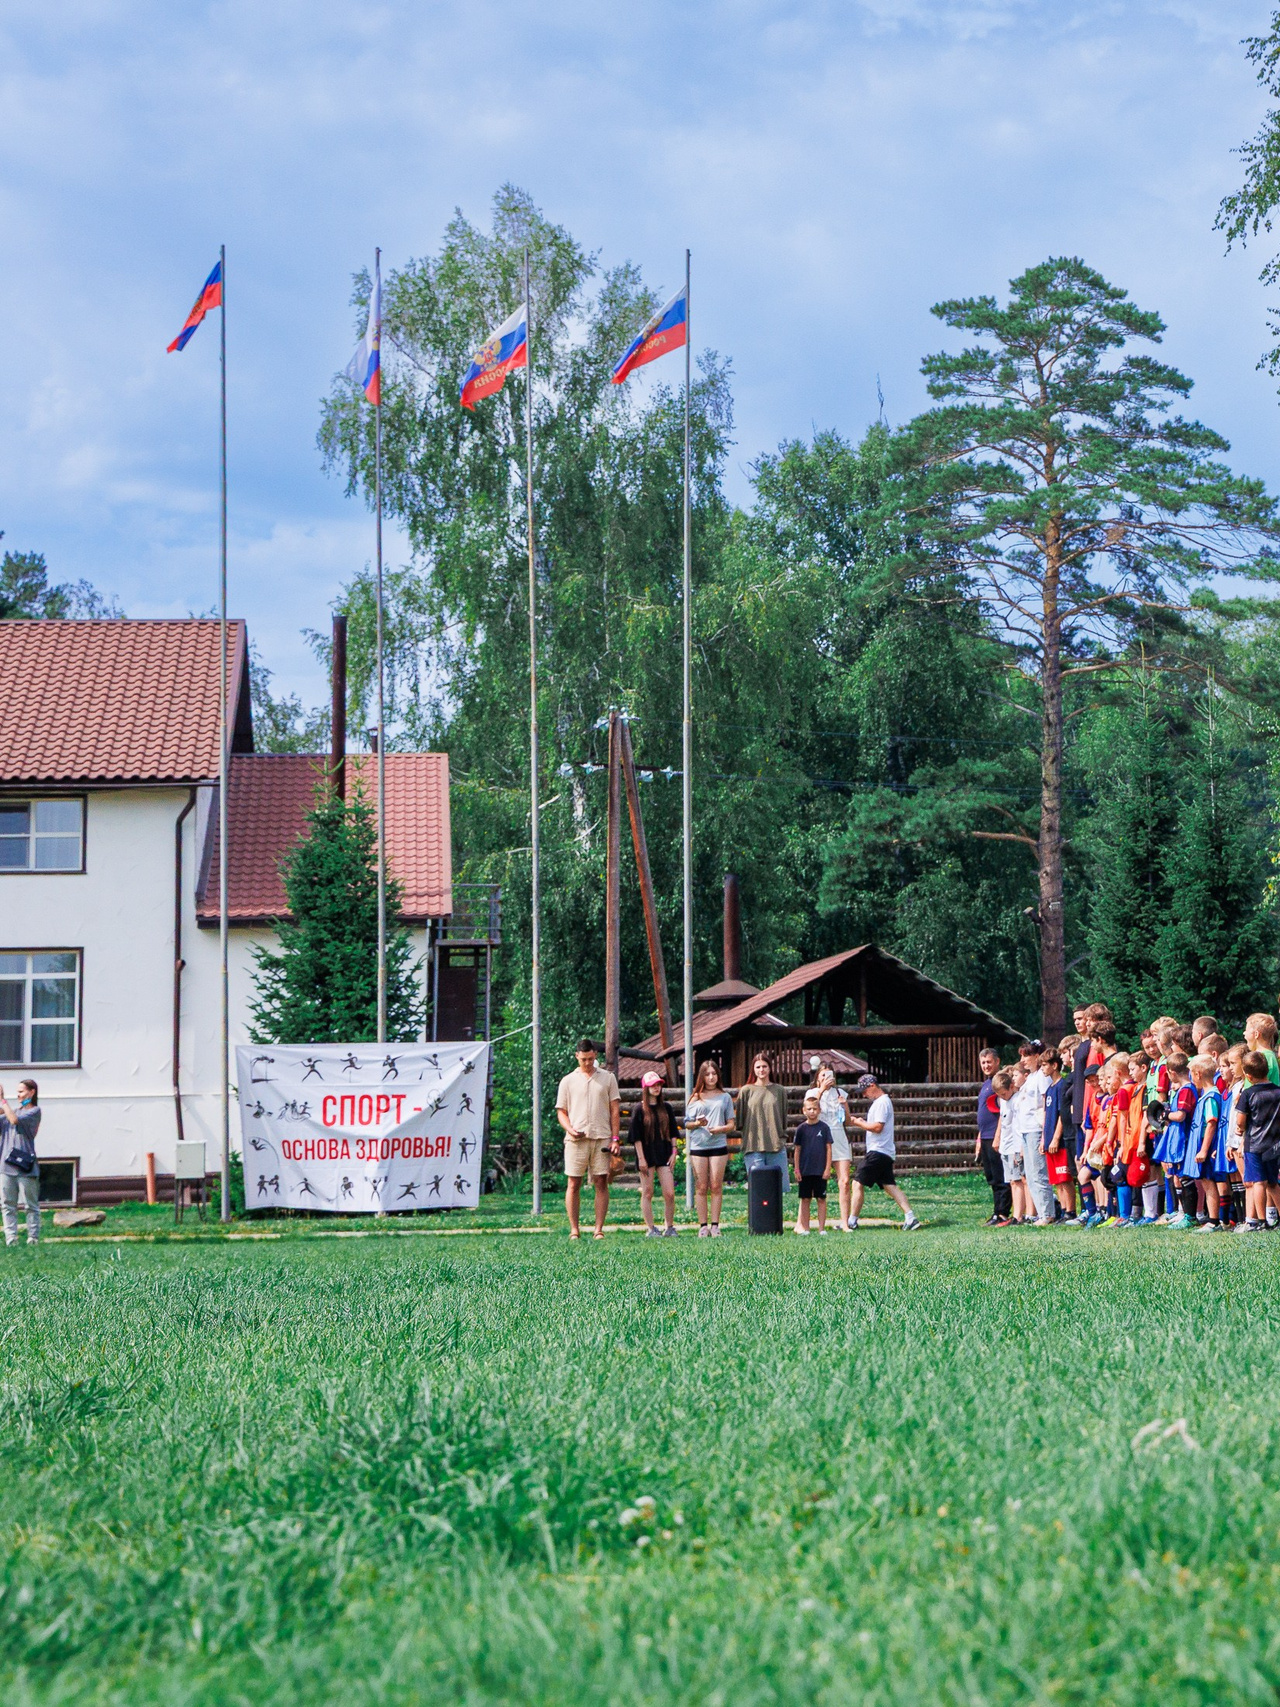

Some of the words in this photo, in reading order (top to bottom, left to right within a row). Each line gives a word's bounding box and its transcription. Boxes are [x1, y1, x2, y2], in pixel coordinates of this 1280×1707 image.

[322, 1094, 407, 1127] СПОРТ
[281, 1138, 351, 1161] ОСНОВА
[356, 1136, 452, 1162] ЗДОРОВЬЯ!
